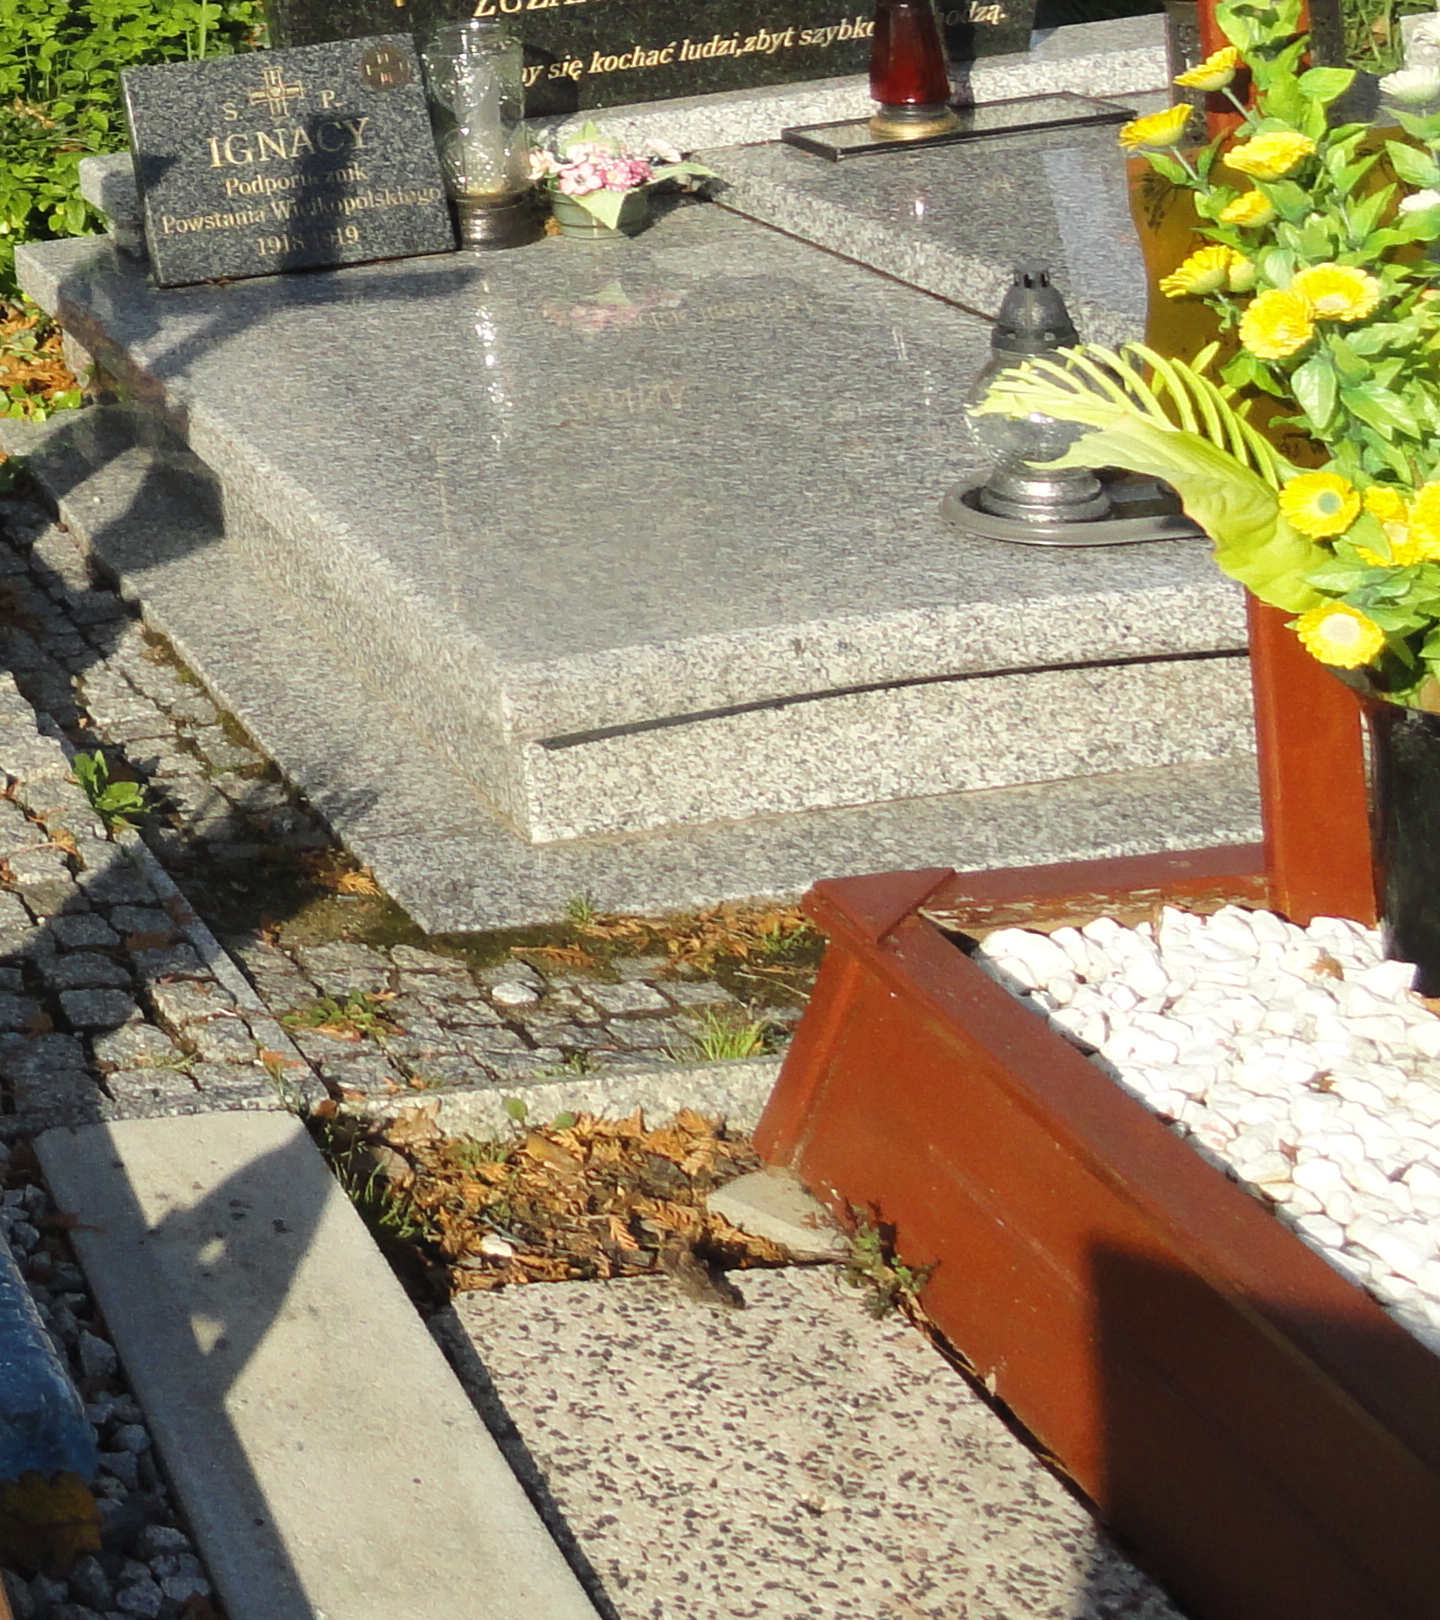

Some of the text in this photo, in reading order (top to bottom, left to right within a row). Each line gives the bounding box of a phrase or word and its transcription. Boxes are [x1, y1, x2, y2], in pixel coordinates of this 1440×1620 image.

[547, 55, 584, 81] się
[587, 41, 677, 75] kochać
[207, 117, 370, 168] IGNACY
[224, 162, 369, 198] Podporucznik
[162, 186, 442, 235] Powstania Wielkopolskiego
